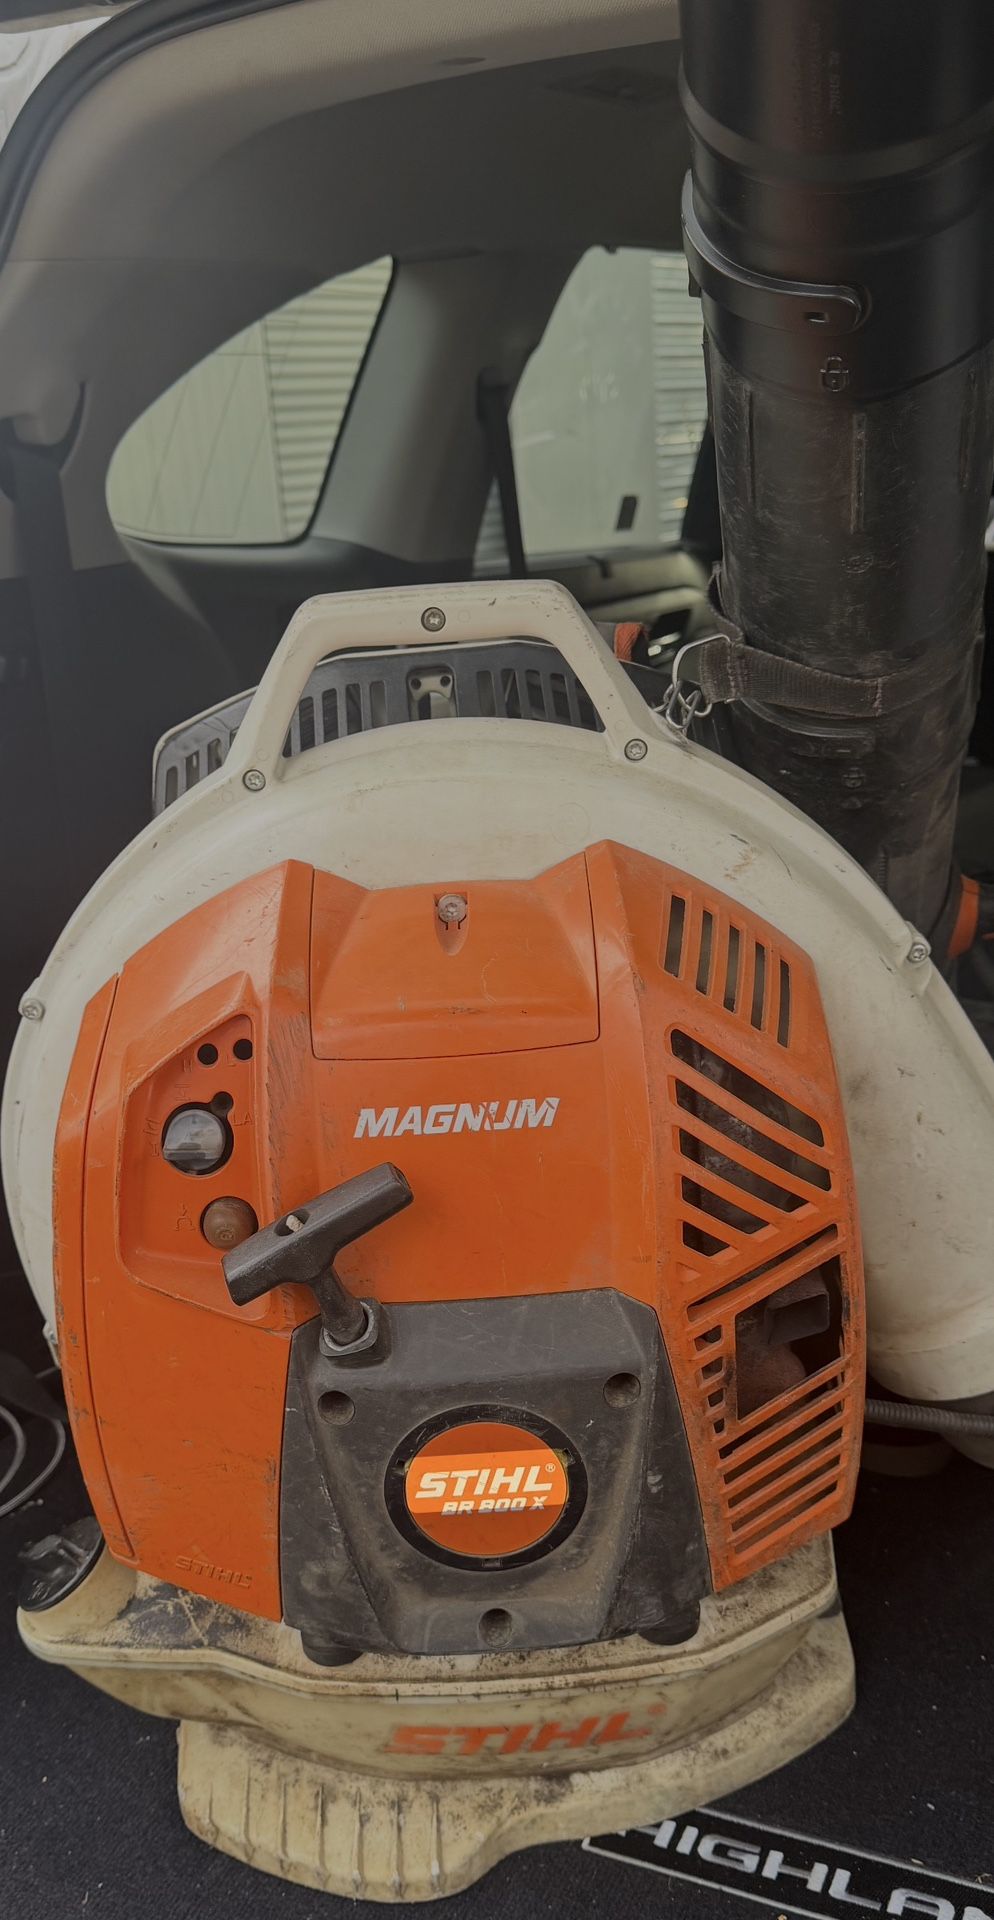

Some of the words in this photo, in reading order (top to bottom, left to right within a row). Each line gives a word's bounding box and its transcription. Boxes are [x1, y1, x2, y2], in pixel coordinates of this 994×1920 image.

[353, 1098, 560, 1138] MAGNUM
[441, 1501, 474, 1516] BR
[478, 1498, 526, 1514] 800
[530, 1496, 548, 1510] X
[175, 1556, 253, 1589] STIHL
[382, 1710, 652, 1757] STIHL
[616, 1820, 994, 1920] HIGHLA
